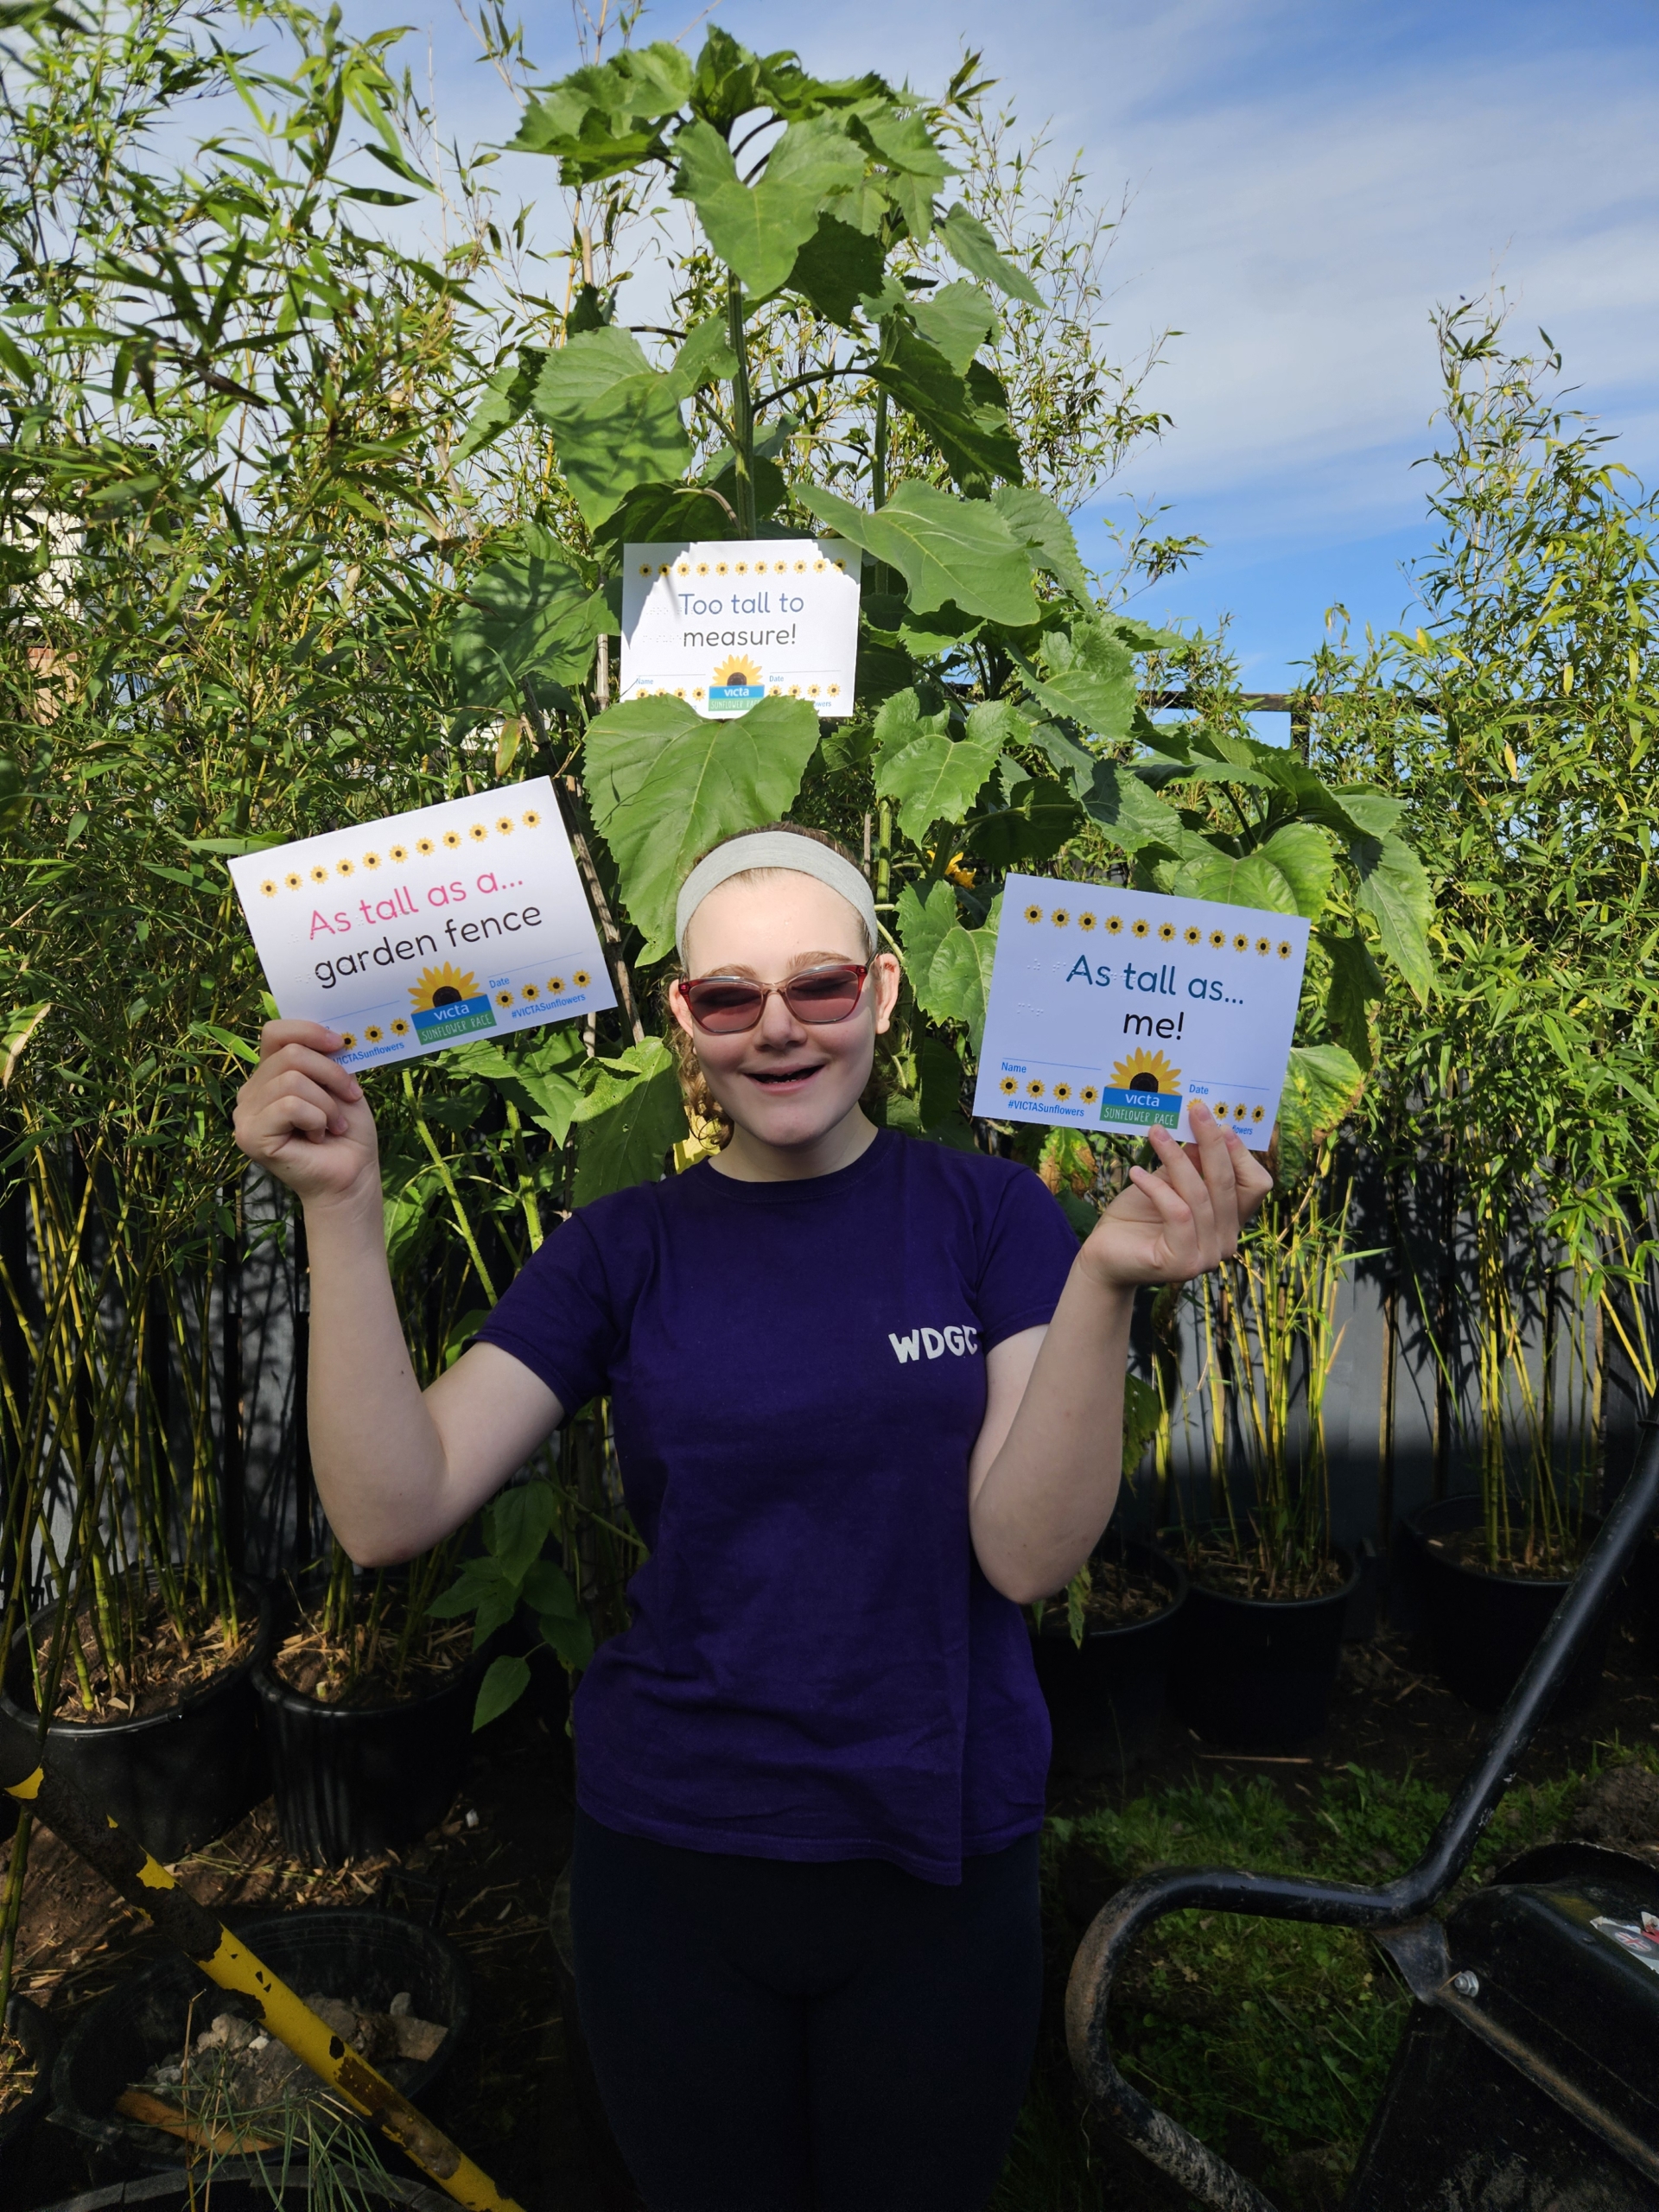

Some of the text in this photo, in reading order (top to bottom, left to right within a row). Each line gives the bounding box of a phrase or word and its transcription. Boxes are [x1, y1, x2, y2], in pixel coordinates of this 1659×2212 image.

[678, 593, 723, 615] Too
[731, 592, 770, 613] tall
[779, 593, 804, 613] to
[683, 623, 797, 647] measure!
[724, 688, 750, 696] victa
[710, 700, 743, 709] SUNFLOWER
[308, 908, 352, 940] As
[359, 886, 419, 925] tall
[427, 880, 467, 907] as
[475, 870, 524, 895] a...
[314, 906, 543, 988] garden fence
[489, 977, 510, 988] Date
[1066, 954, 1111, 987] As
[1123, 963, 1177, 995] tall
[1188, 977, 1244, 1005] as...
[434, 1004, 470, 1020] victa
[512, 994, 586, 1019] #VICTASunflowers
[422, 1014, 493, 1041] SUNFLOWER RACE
[1123, 1012, 1185, 1040] me!
[1001, 1061, 1027, 1074] Name
[1189, 1084, 1209, 1095] Date
[1007, 1100, 1084, 1117] #VICTASunflowers
[1125, 1094, 1160, 1107] victa
[1103, 1107, 1174, 1126] SUNFLOWER RACE
[888, 1325, 977, 1363] WDGC
